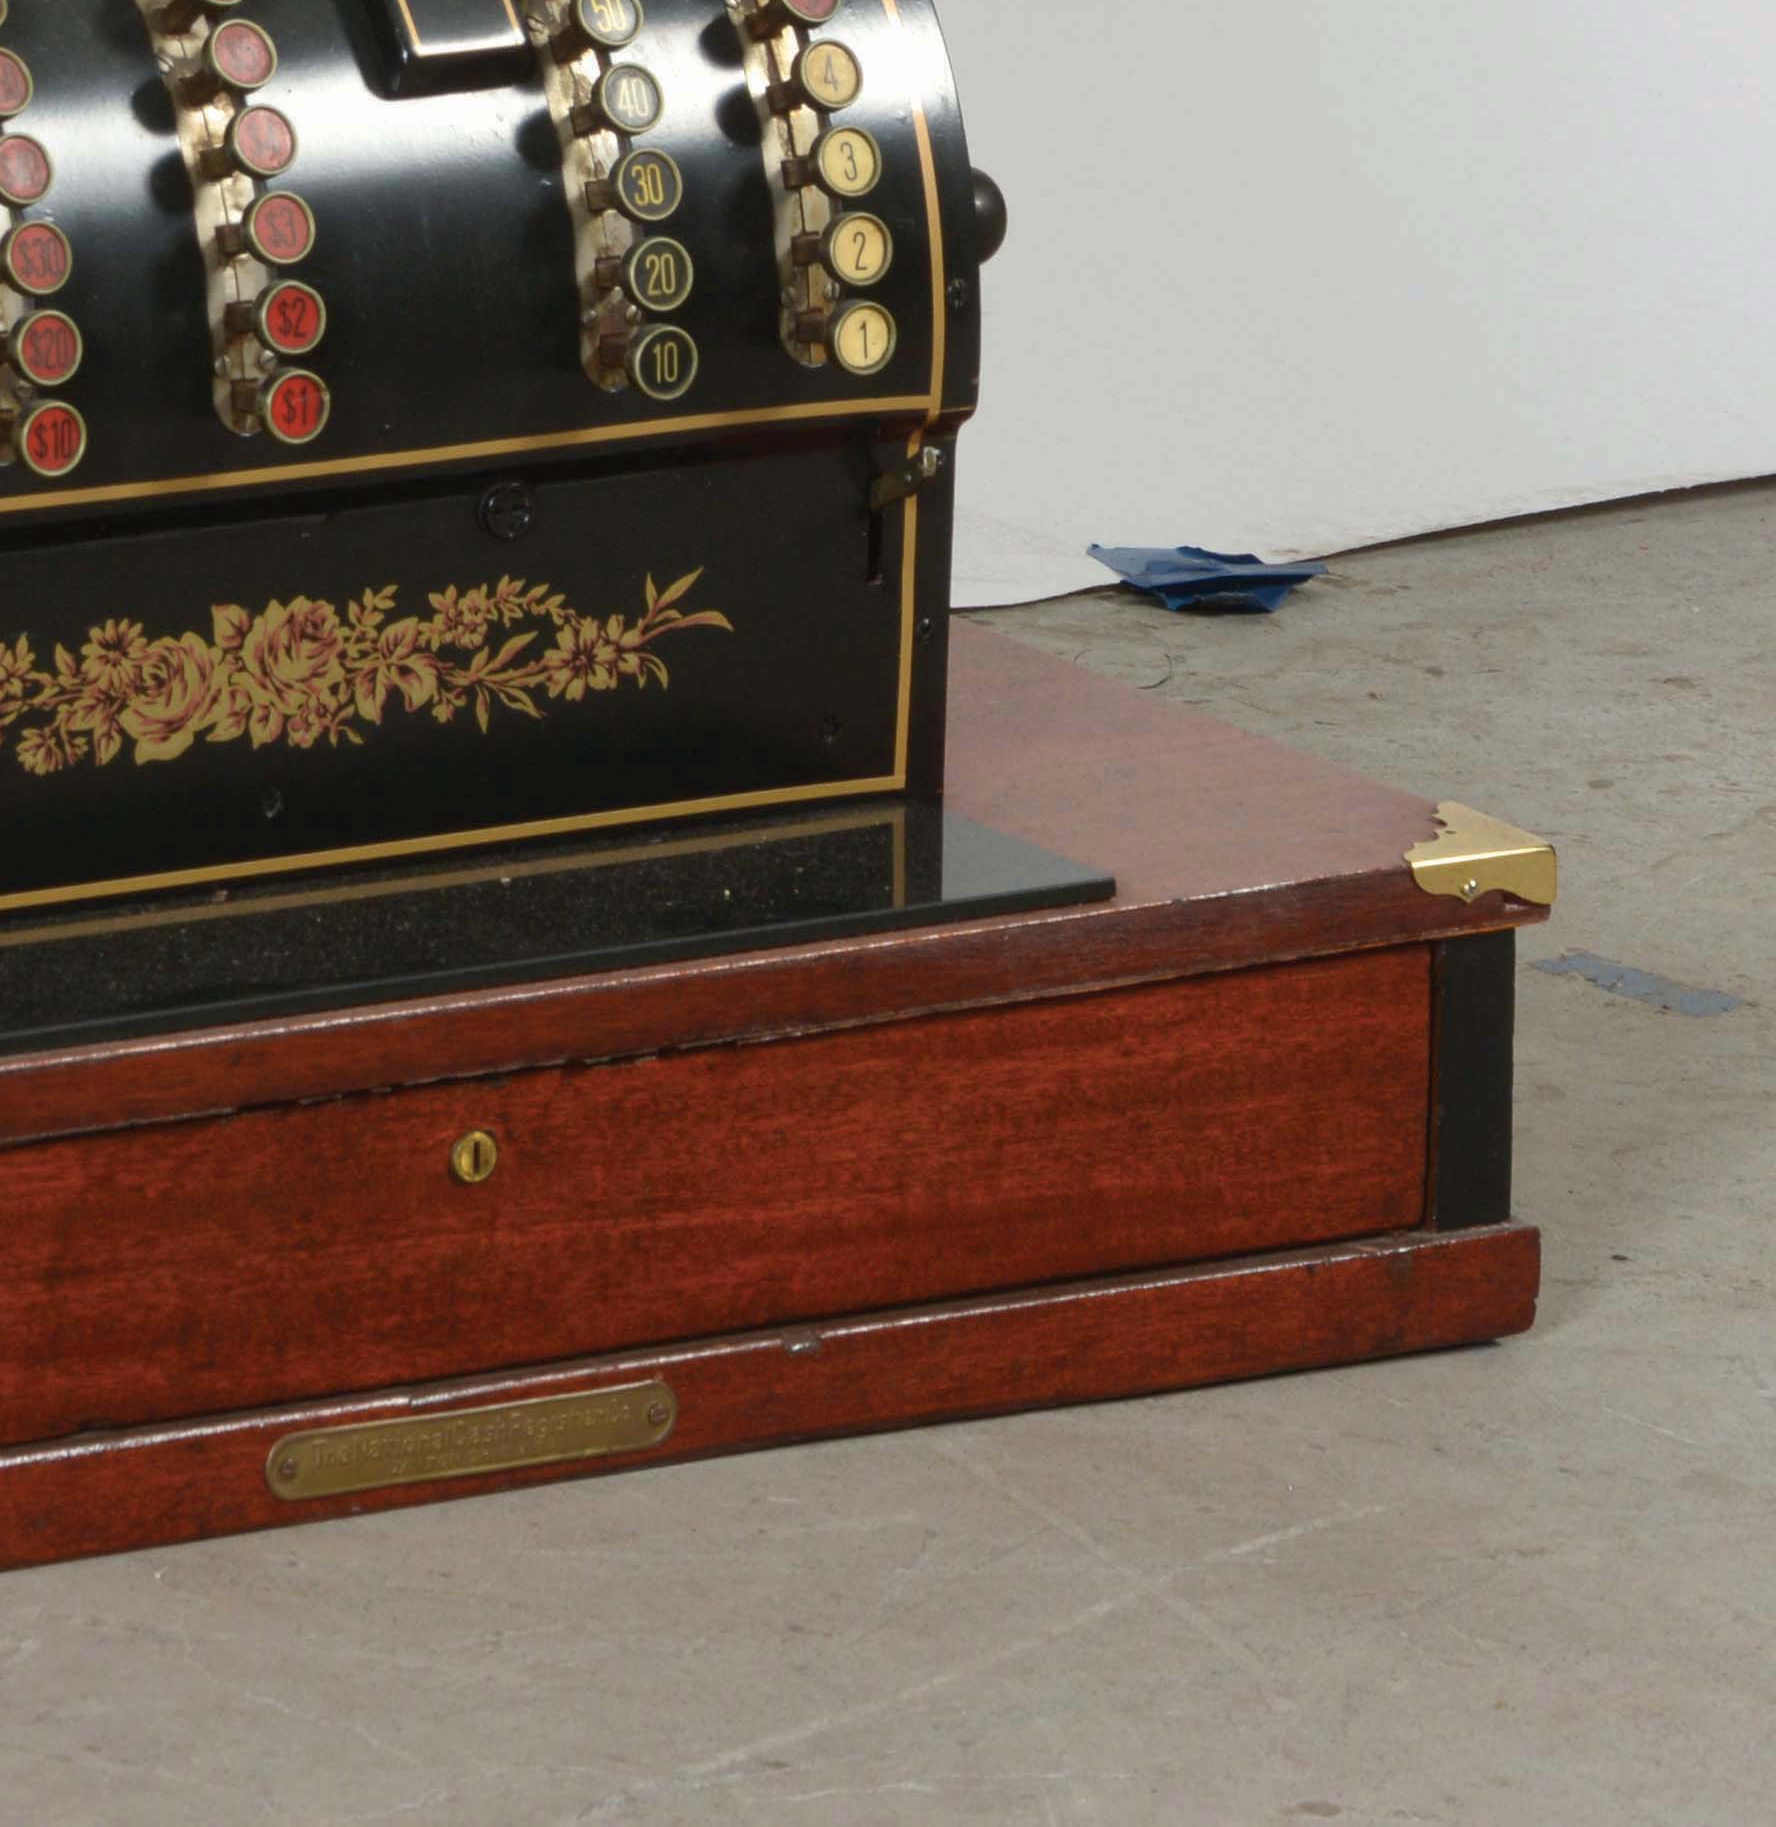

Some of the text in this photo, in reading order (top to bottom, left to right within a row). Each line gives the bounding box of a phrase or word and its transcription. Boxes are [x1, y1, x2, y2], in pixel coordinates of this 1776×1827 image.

[822, 53, 842, 93] 4
[617, 75, 650, 119] 40
[840, 140, 859, 181] 3
[632, 163, 665, 206] 30
[852, 230, 869, 271] 2
[645, 252, 677, 297] 20
[276, 296, 308, 340] $2
[652, 340, 679, 385] 10
[281, 387, 311, 428] $1
[32, 417, 75, 462] $10
